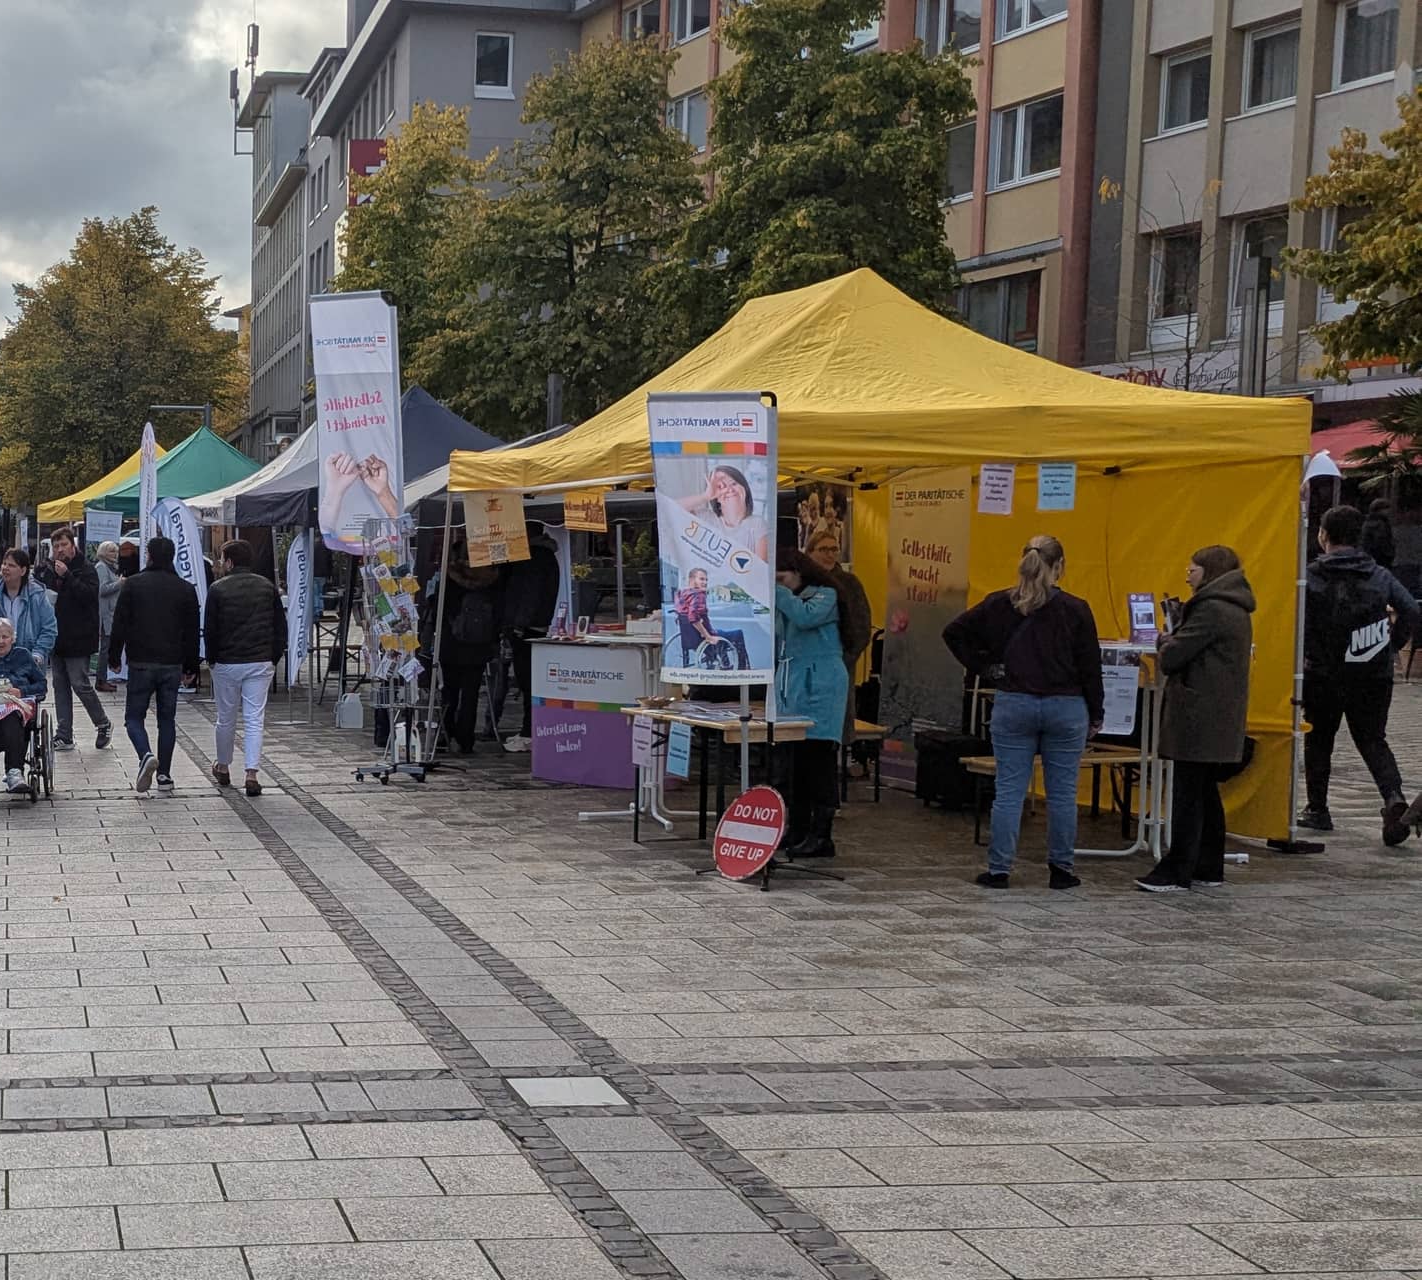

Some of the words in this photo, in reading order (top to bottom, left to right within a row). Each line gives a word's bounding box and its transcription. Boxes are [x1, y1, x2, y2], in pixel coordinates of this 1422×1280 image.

[901, 538, 952, 564] Selbsthilfe
[908, 565, 939, 584] macht
[1351, 617, 1390, 653] NIKE
[571, 670, 625, 680] PARITÄTISCHE
[733, 804, 751, 818] DO
[752, 806, 778, 822] NOT
[719, 842, 746, 859] GIVE
[747, 847, 765, 861] UP
